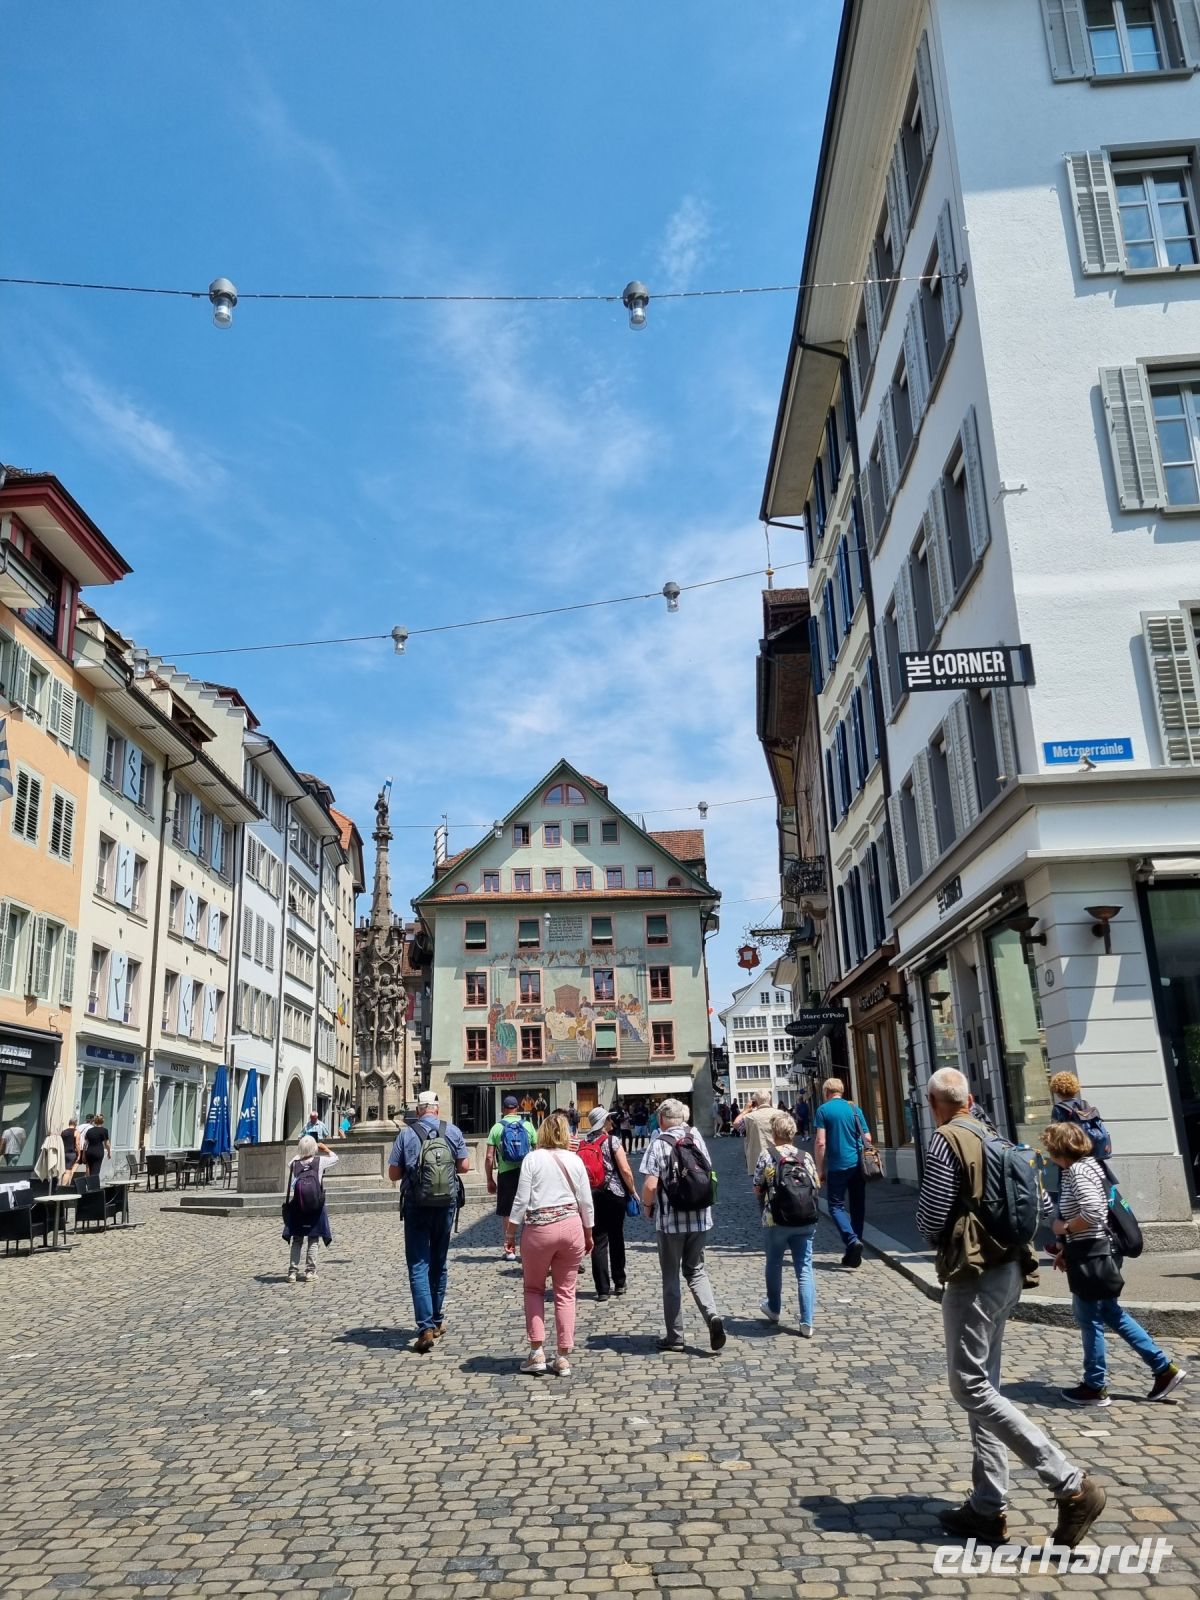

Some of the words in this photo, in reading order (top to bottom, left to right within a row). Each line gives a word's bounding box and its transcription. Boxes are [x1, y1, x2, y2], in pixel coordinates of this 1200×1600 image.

[905, 655, 932, 687] THE
[932, 650, 1005, 675] CORNER
[951, 675, 1007, 684] PHÄNOMEN
[170, 1062, 191, 1074] INSTORE
